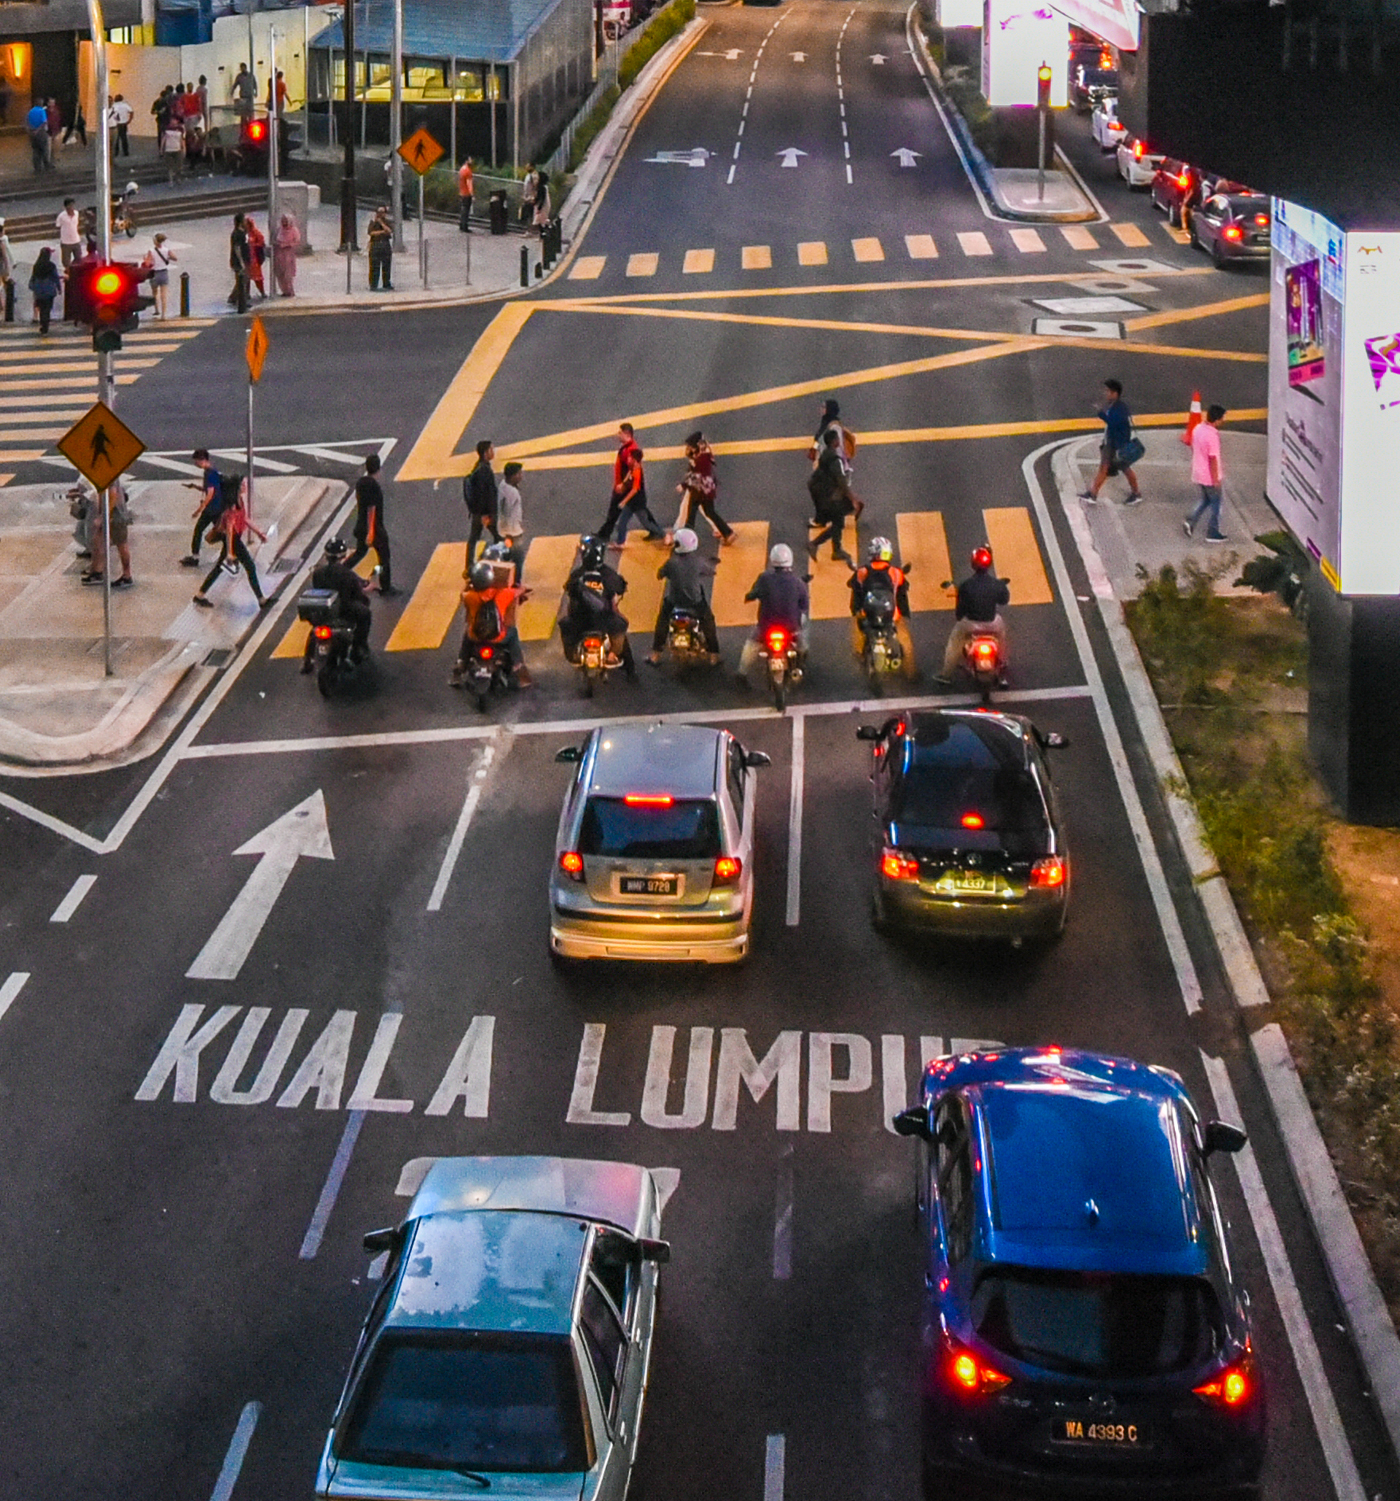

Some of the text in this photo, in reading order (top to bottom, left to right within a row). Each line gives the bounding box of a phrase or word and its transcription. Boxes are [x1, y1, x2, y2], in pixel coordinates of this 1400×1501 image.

[134, 1003, 1008, 1137] KUALA LUMPU
[1065, 1421, 1138, 1442] WA 4393 C
